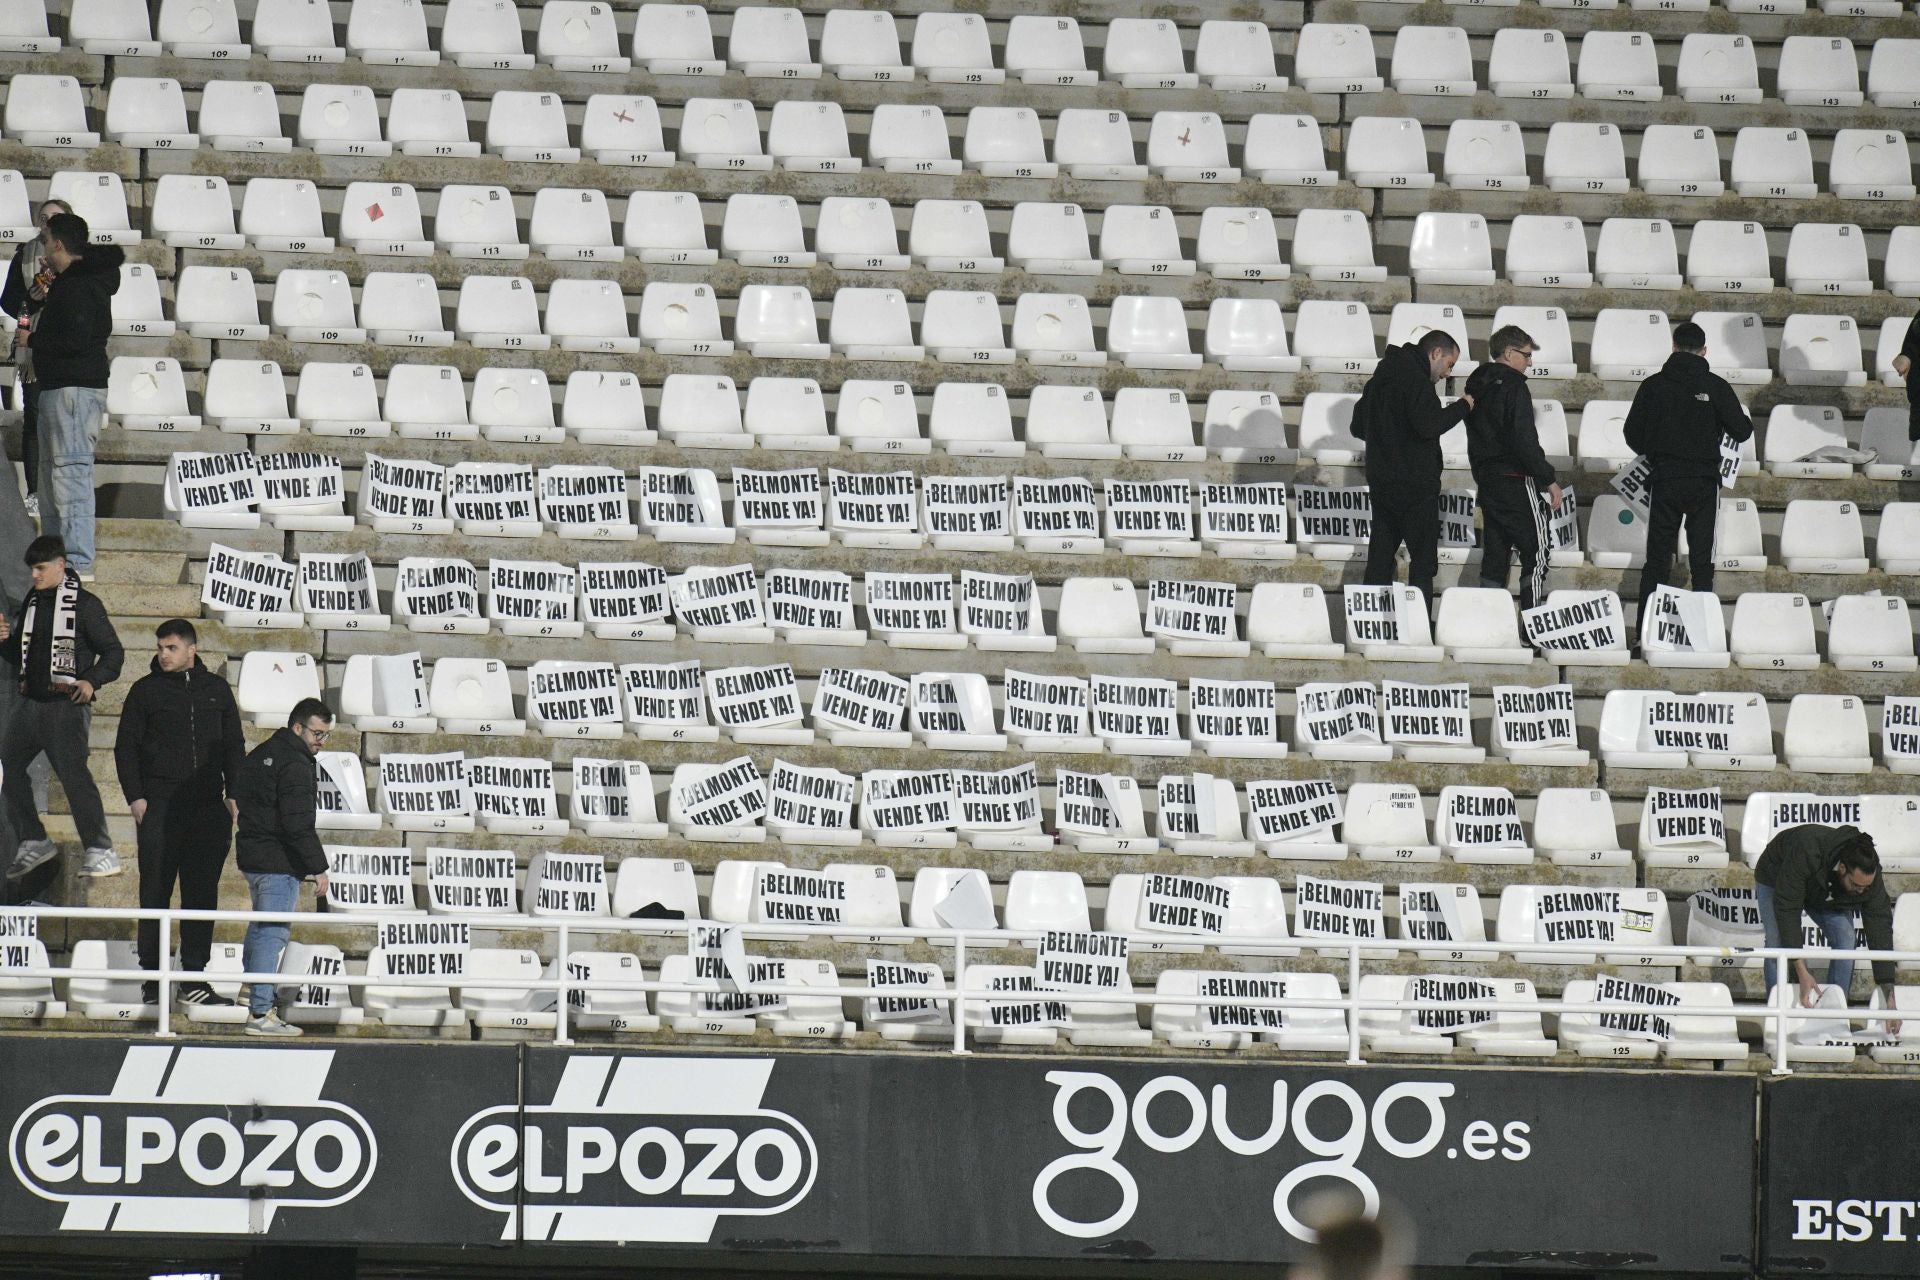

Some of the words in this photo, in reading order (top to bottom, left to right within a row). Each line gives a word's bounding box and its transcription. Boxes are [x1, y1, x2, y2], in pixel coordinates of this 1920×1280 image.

[178, 452, 254, 483] ¡BELMONTE
[370, 460, 442, 492] ¡BELMONTE
[1901, 470, 1912, 478] 95
[184, 484, 228, 507] VENDE
[229, 478, 254, 500] YA!
[450, 472, 532, 498] ¡BELMONTE
[736, 474, 819, 496] ¡BELMONTE
[832, 476, 913, 496] ¡BELMONTE
[926, 483, 1006, 506] ¡BELMONTE
[1017, 484, 1095, 506] ¡BELMONTE
[1107, 484, 1189, 506] ¡BELMONTE
[1201, 485, 1286, 508] ¡BELMONTE
[371, 488, 408, 516] VENDE
[412, 498, 434, 517] YA!
[455, 502, 503, 520] VENDE
[505, 500, 529, 518] YA!
[742, 501, 790, 519] VENDE
[792, 501, 816, 519] YA!
[839, 501, 884, 522] VENDE
[887, 503, 909, 522] YA!
[931, 512, 976, 532] VENDE
[980, 510, 1001, 531] YA!
[1023, 511, 1071, 530] VENDE
[1073, 511, 1094, 530] YA!
[1114, 511, 1161, 530] VENDE
[1164, 512, 1185, 531] YA!
[1208, 512, 1254, 532] VENDE
[1258, 514, 1280, 533] YA!
[208, 554, 294, 591] ¡BELMONTE
[583, 568, 666, 593] ¡BELMONTE
[211, 579, 256, 610] VENDE
[260, 594, 282, 612] YA!
[767, 576, 849, 602] ¡BELMONTE
[590, 598, 637, 617] VENDE
[639, 593, 662, 614] YA!
[773, 602, 815, 626] VENDE
[820, 609, 841, 628] YA!
[1528, 596, 1612, 640] ¡BELMONTE
[532, 669, 616, 706] ¡BELMONTE
[625, 667, 700, 692] ¡BELMONTE
[538, 699, 588, 720] VENDE
[590, 696, 614, 717] YA!
[634, 696, 675, 718] VENDE
[679, 697, 699, 718] YA!
[1192, 686, 1274, 709] ¡BELMONTE
[1386, 688, 1468, 710] ¡BELMONTE
[1197, 714, 1242, 736] VENDE
[1246, 717, 1268, 735] YA!
[1650, 702, 1733, 725] ¡BELMONTE
[1391, 715, 1439, 735] VENDE
[1442, 716, 1463, 737] YA!
[1655, 730, 1703, 748] VENDE
[1706, 733, 1728, 750] YA!
[383, 760, 464, 786] ¡BELMONTE
[1730, 758, 1740, 766] 91
[957, 769, 1036, 798] ¡BELMONTE
[389, 791, 434, 811] VENDE
[437, 789, 460, 810] YA!
[963, 803, 1011, 822] VENDE
[1013, 798, 1035, 821] YA!
[1251, 782, 1335, 818] ¡BELMONTE
[1260, 810, 1310, 834] VENDE
[1310, 803, 1335, 823] YA!
[1774, 803, 1860, 827] ¡BELMONTE
[1396, 850, 1412, 858] 127
[429, 856, 514, 880] ¡BELMONTE
[434, 885, 481, 906] VENDE
[485, 888, 508, 907] YA!
[761, 874, 845, 900] ¡BELMONTE
[1146, 875, 1229, 914] ¡BELMONTE
[1299, 882, 1381, 910] ¡BELMONTE
[766, 901, 814, 920] VENDE
[817, 907, 840, 922] YA!
[1150, 902, 1198, 927] VENDE
[1202, 910, 1222, 933] YA!
[1538, 892, 1619, 919] ¡BELMONTE
[1303, 910, 1349, 934] VENDE
[1353, 918, 1374, 937] YA!
[1545, 920, 1594, 942] VENDE
[1596, 920, 1614, 941] YA!
[381, 923, 468, 949] ¡BELMONTE
[1040, 931, 1127, 958] ¡BELMONTE
[387, 954, 435, 974] VENDE
[440, 954, 462, 974] YA!
[1044, 961, 1092, 984] VENDE
[1097, 965, 1119, 987] YA!
[609, 1019, 627, 1028] 105
[1793, 1200, 1920, 1241] EST
